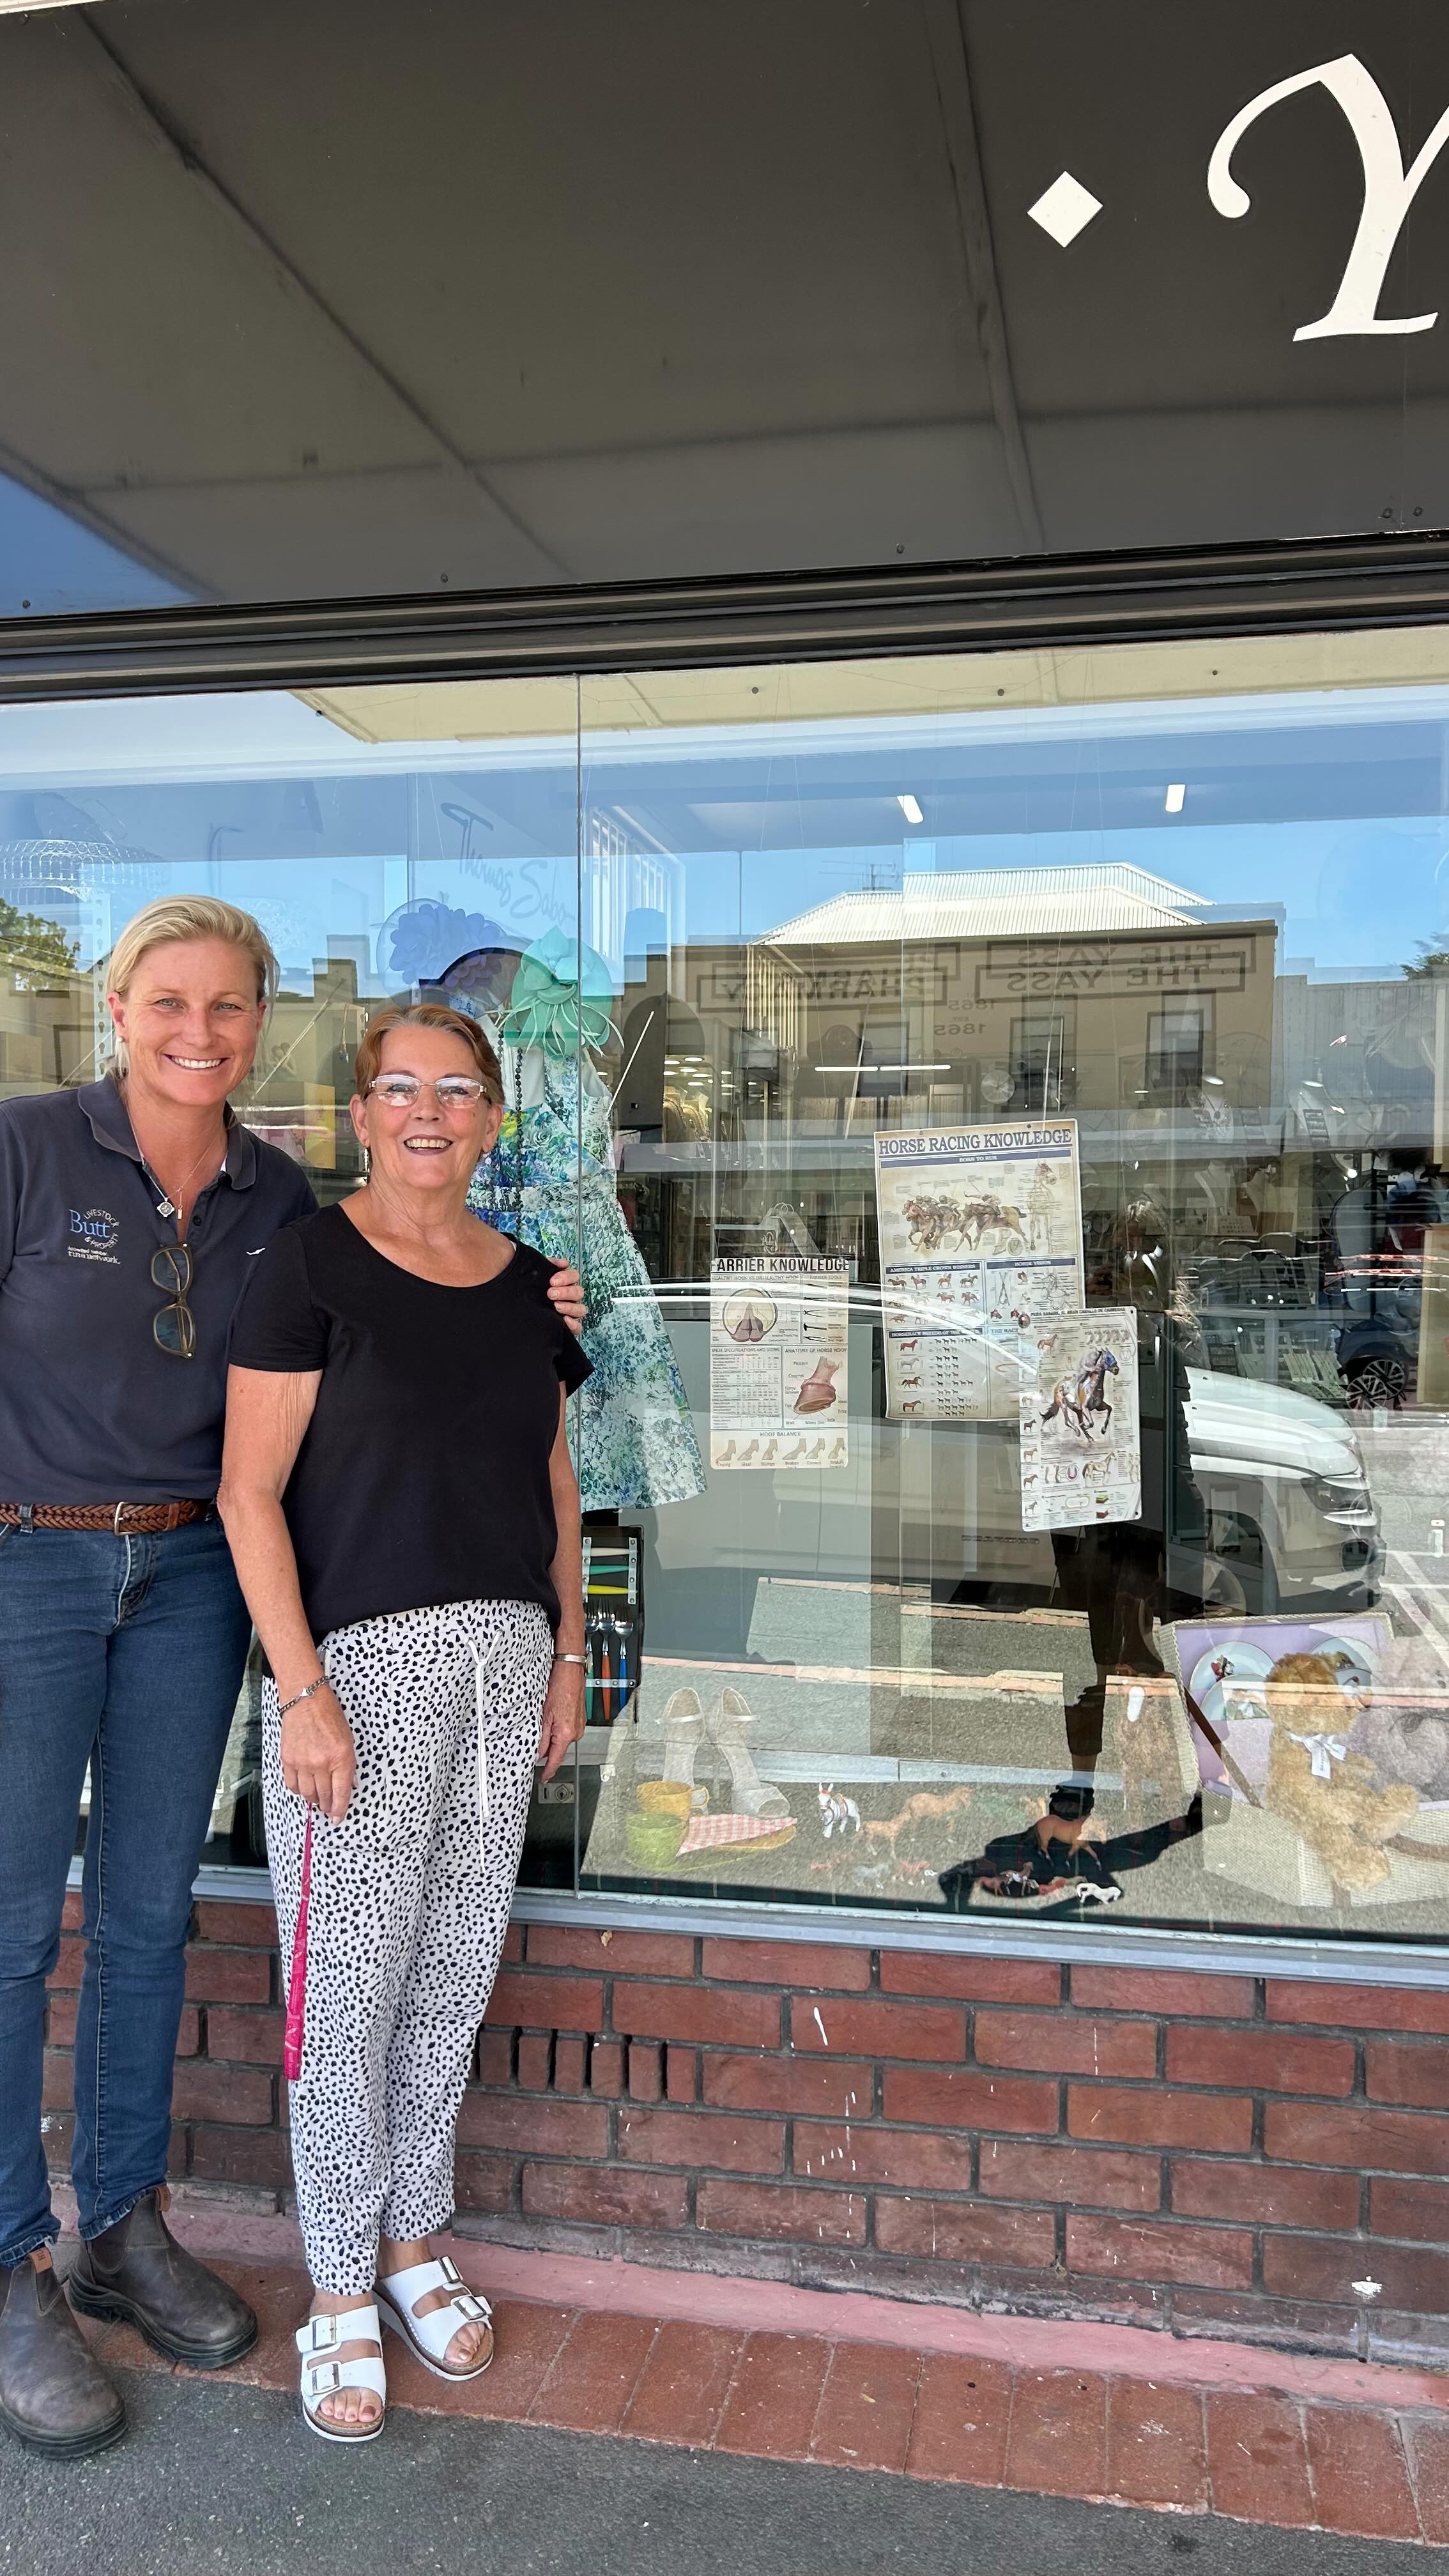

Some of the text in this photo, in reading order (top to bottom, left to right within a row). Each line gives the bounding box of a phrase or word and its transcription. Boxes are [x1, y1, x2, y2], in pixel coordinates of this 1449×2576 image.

[510, 858, 576, 926] Sabo
[878, 1129, 1071, 1155] HORSE RACING KNOWLEDGE
[69, 1209, 111, 1238] Butt
[84, 1209, 119, 1227] LIVESTOCK
[770, 1258, 849, 1271] KNOWLEDGE
